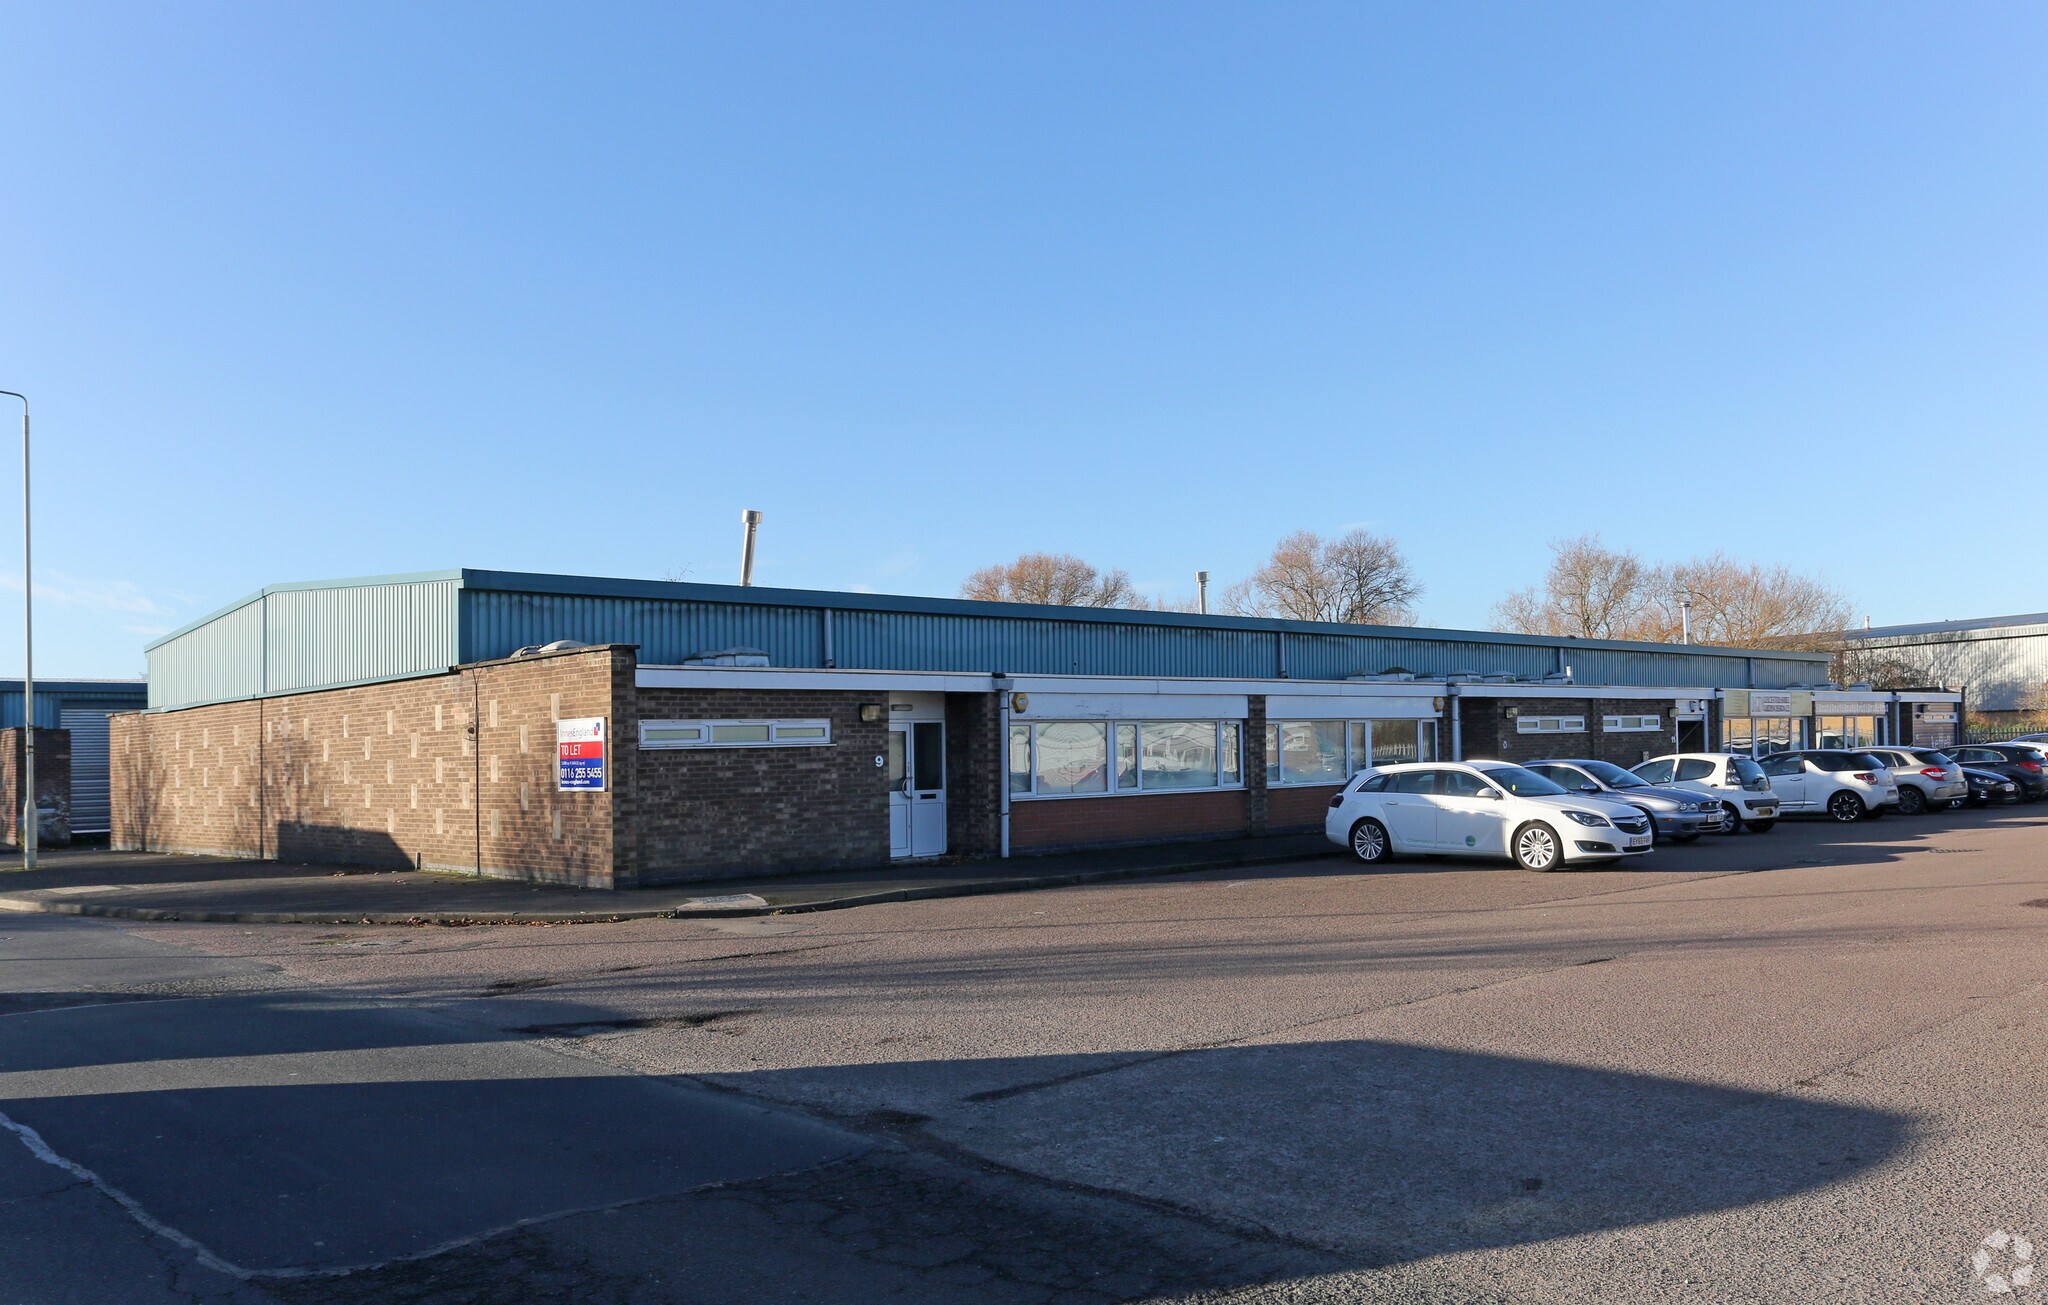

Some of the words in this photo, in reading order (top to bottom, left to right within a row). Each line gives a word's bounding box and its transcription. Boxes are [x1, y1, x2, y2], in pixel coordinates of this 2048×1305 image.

[561, 745, 569, 756] TO
[570, 744, 581, 756] LET
[875, 755, 884, 768] 9
[560, 768, 575, 778] 0116
[575, 768, 586, 778] 255
[587, 767, 602, 778] 5455
